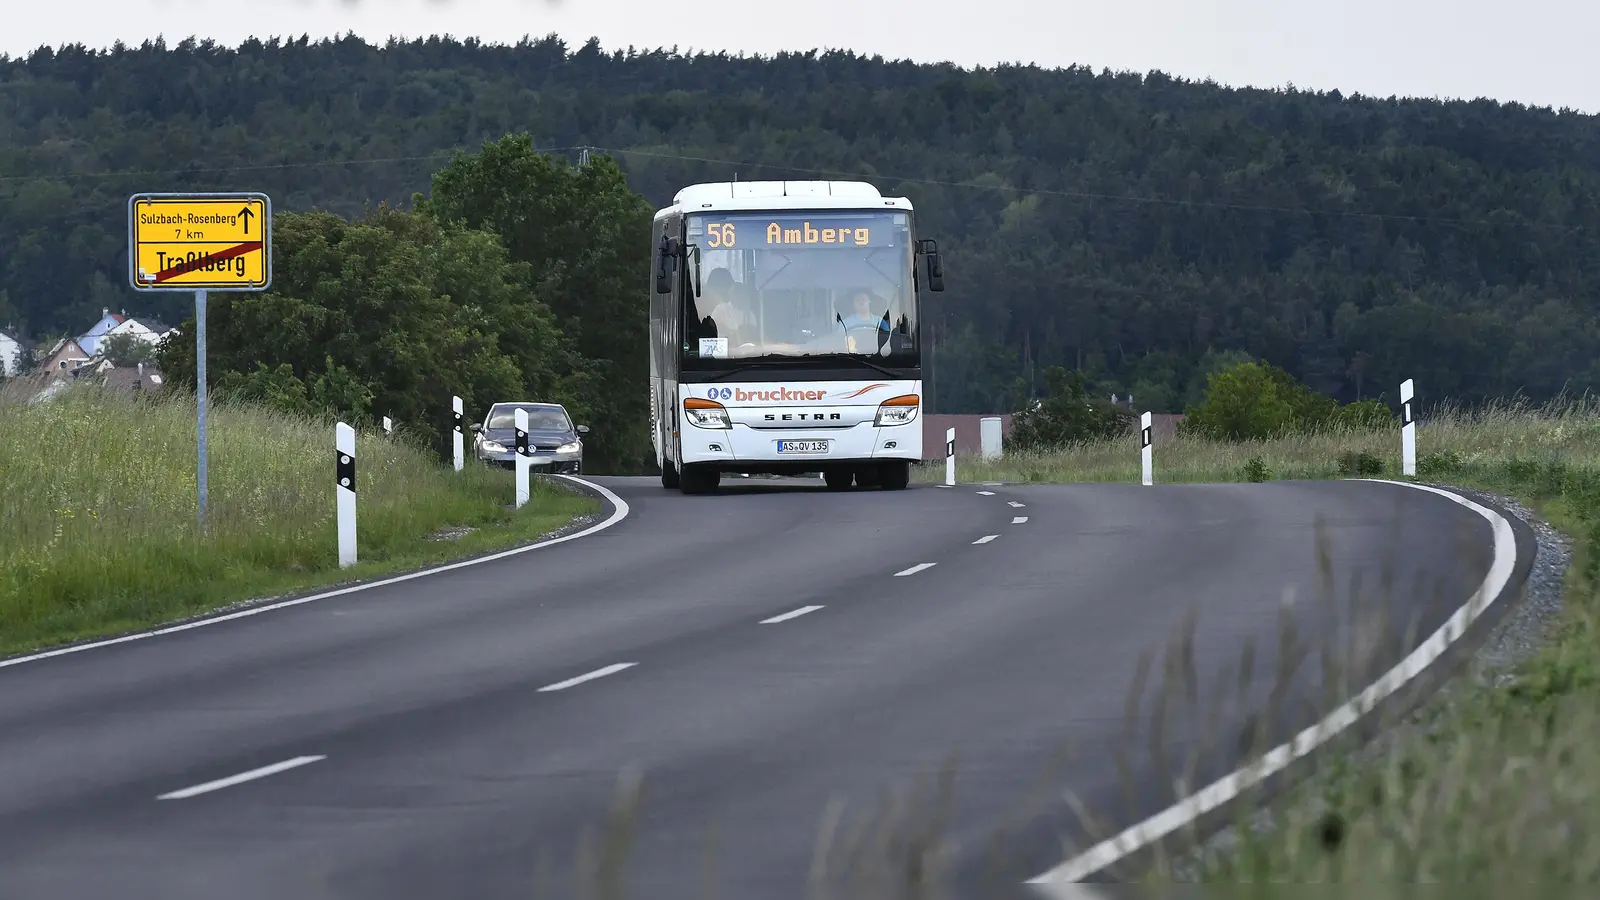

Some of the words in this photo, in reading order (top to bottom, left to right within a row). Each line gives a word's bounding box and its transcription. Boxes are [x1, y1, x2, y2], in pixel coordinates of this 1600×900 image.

[140, 213, 236, 226] Sulzbach-Rosenberg
[175, 229, 181, 239] 7
[186, 229, 204, 239] km
[707, 223, 736, 247] 56
[766, 222, 869, 245] Amberg
[156, 251, 245, 277] Traßlberg
[735, 387, 827, 402] bruckner
[764, 413, 841, 421] SETRA
[783, 442, 794, 451] AS
[798, 442, 810, 451] QV
[811, 441, 828, 451] 135
